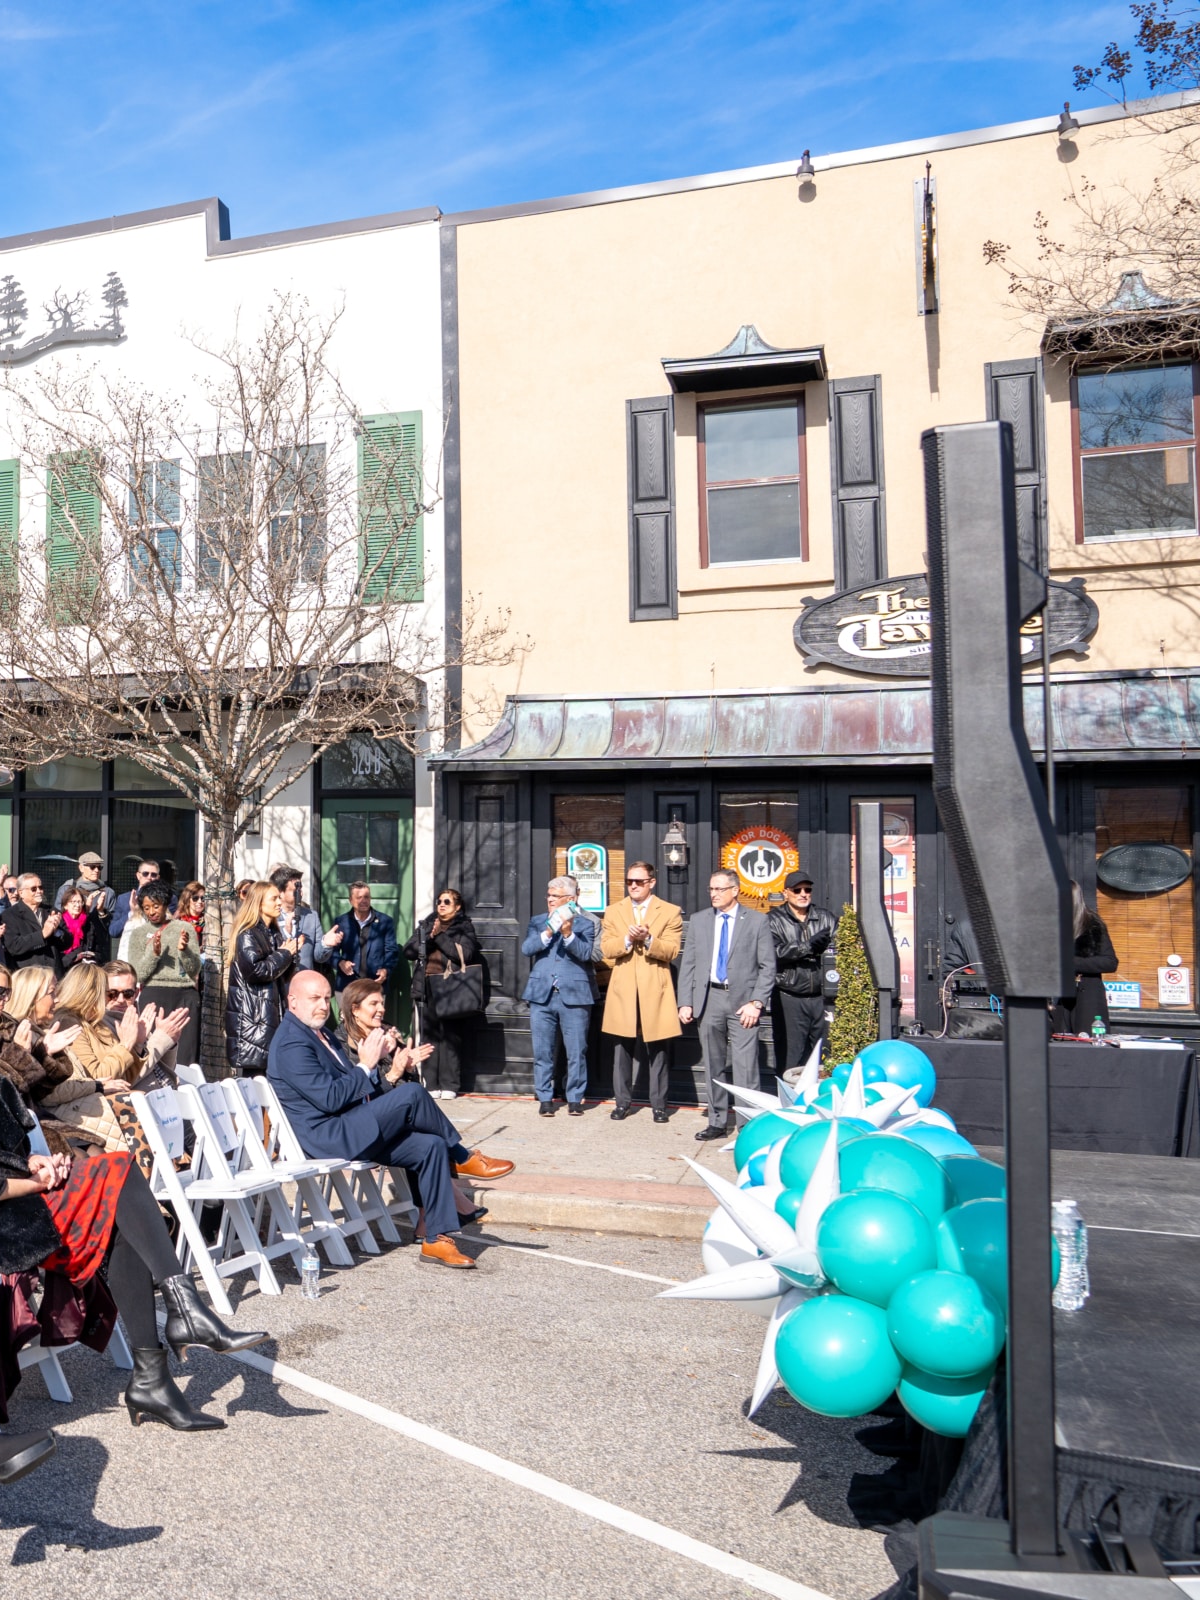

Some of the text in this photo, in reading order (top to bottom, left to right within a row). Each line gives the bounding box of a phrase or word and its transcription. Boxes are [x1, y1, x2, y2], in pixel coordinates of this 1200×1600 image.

[858, 587, 930, 615] The
[351, 746, 371, 775] 529
[736, 831, 755, 846] FOR
[759, 829, 780, 842] DOG
